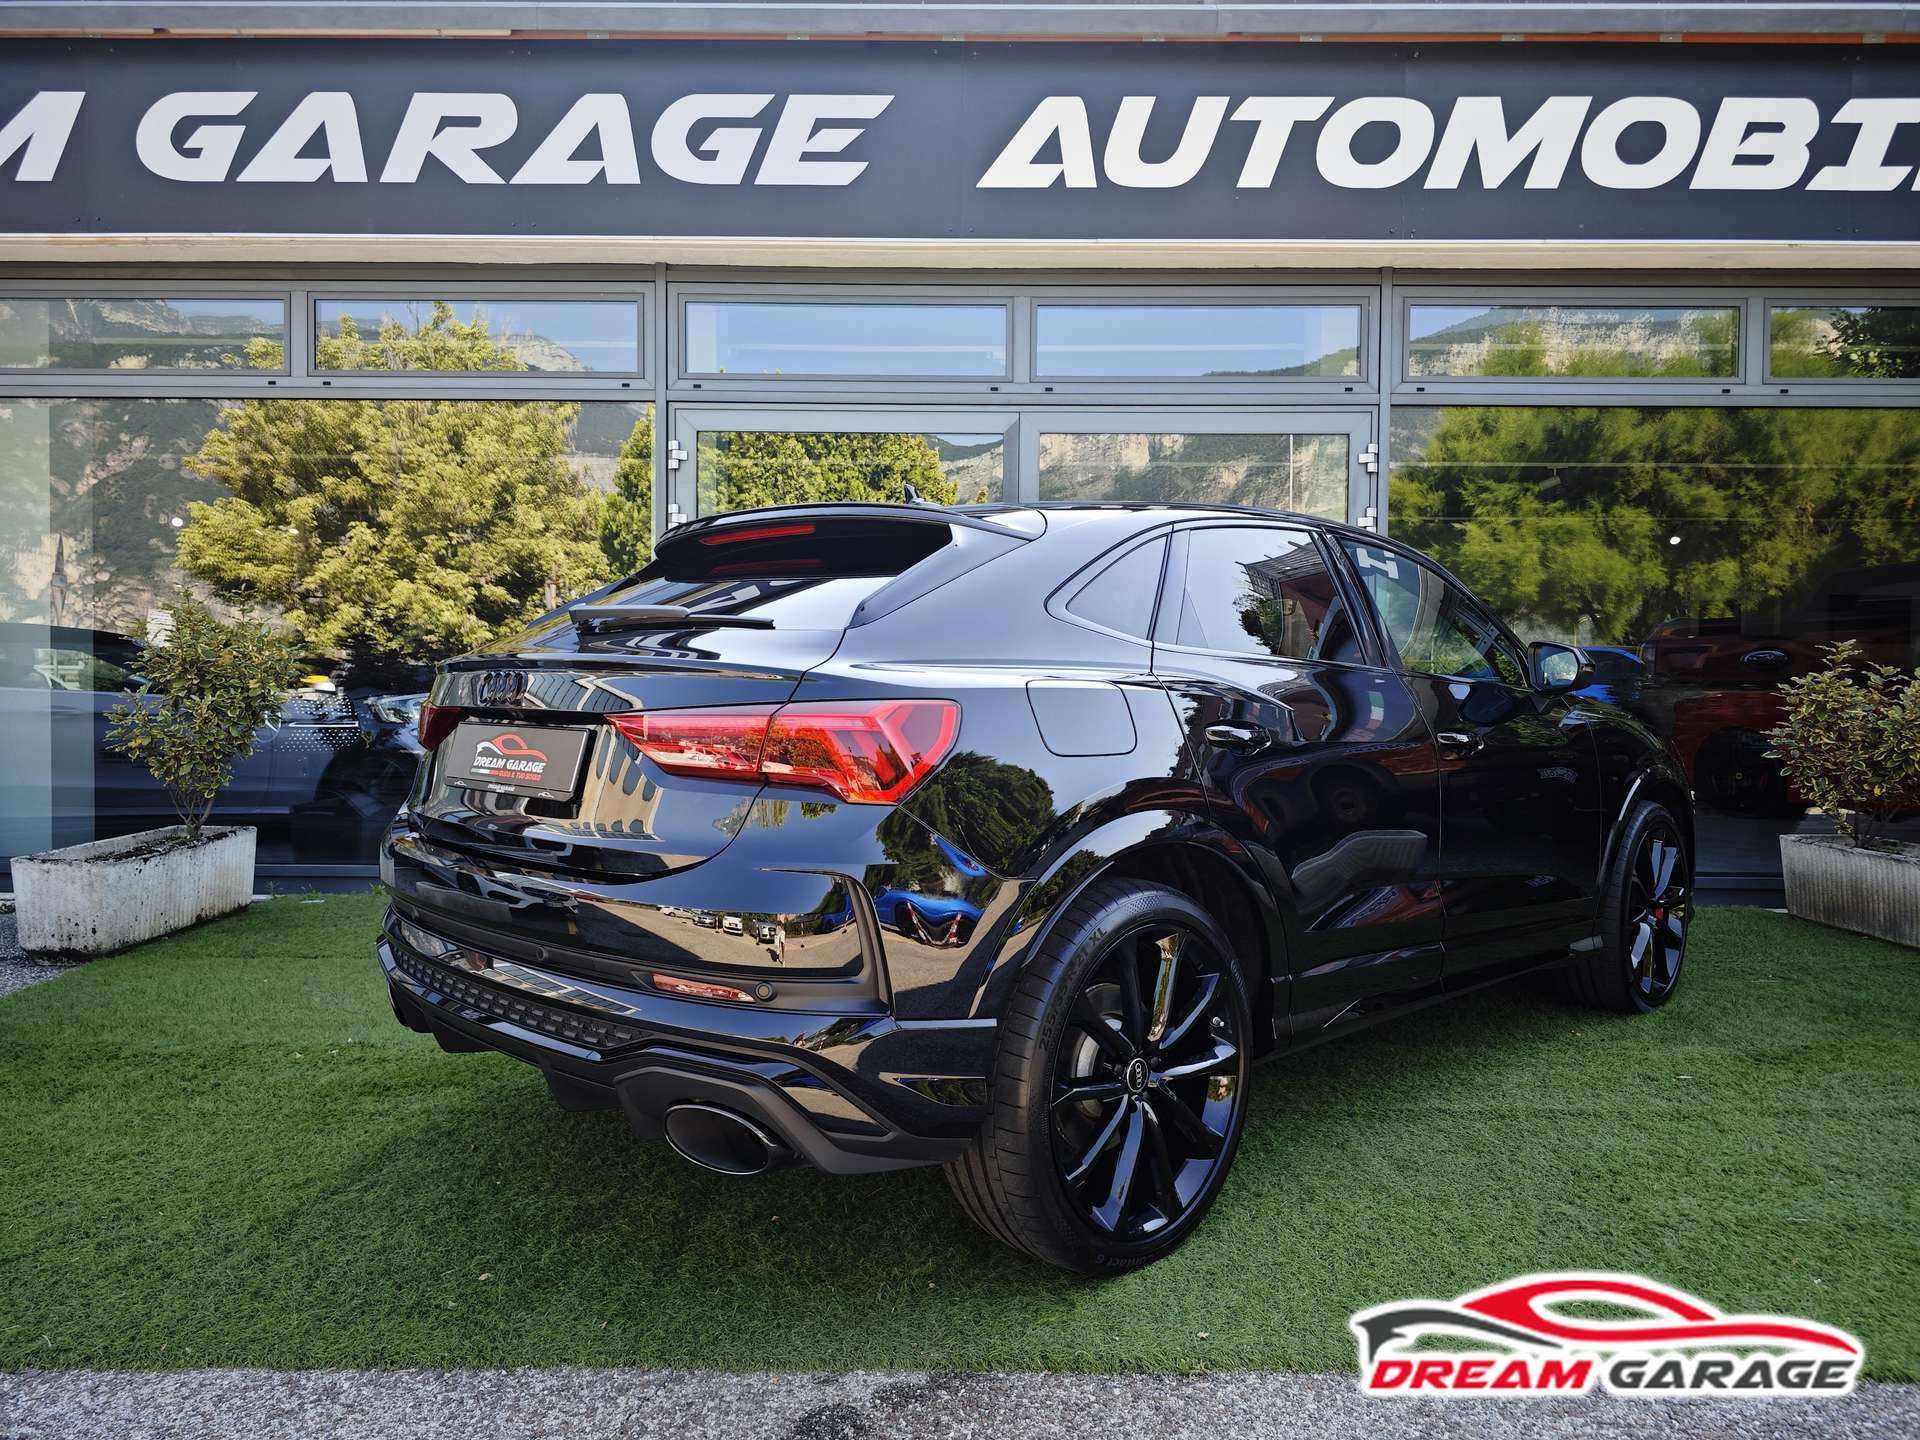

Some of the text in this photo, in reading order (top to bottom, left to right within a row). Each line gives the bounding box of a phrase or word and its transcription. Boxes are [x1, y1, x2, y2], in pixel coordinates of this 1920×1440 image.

[135, 91, 896, 186] GARAGE
[975, 95, 1920, 190] AUTOMOBI
[473, 756, 546, 773] DREAM GARAGE
